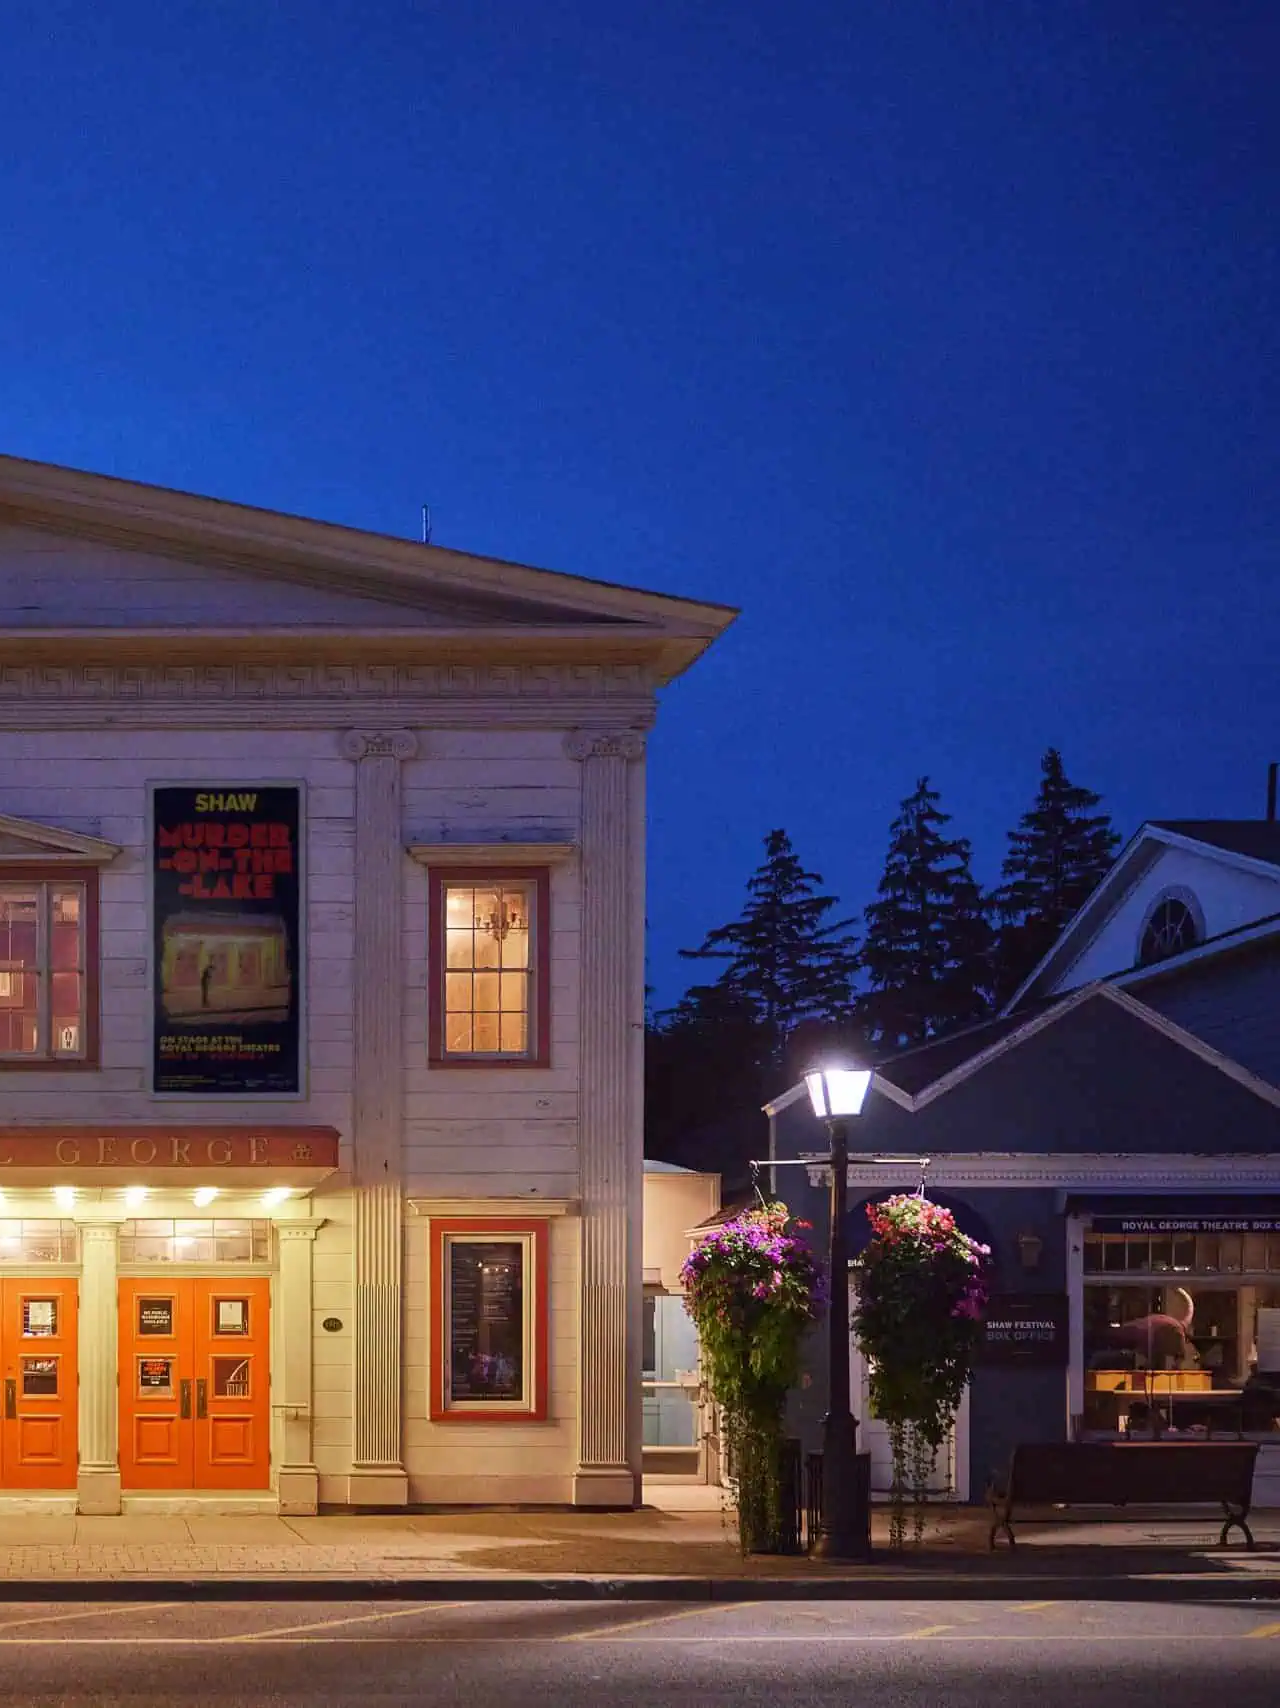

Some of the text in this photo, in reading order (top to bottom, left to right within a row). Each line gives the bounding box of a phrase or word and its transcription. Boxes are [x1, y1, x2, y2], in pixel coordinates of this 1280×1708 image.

[195, 793, 257, 812] SHAW
[159, 822, 290, 848] MURDER
[55, 1137, 270, 1166] GEORGE
[1121, 1221, 1155, 1231] ROYAL
[1159, 1221, 1198, 1231] GEORGE
[1201, 1221, 1248, 1231] THEATRE
[1252, 1221, 1272, 1231] BOX
[986, 1320, 1056, 1329] SHAW FESTIVAL
[987, 1331, 1055, 1341] BOX OFFICE
